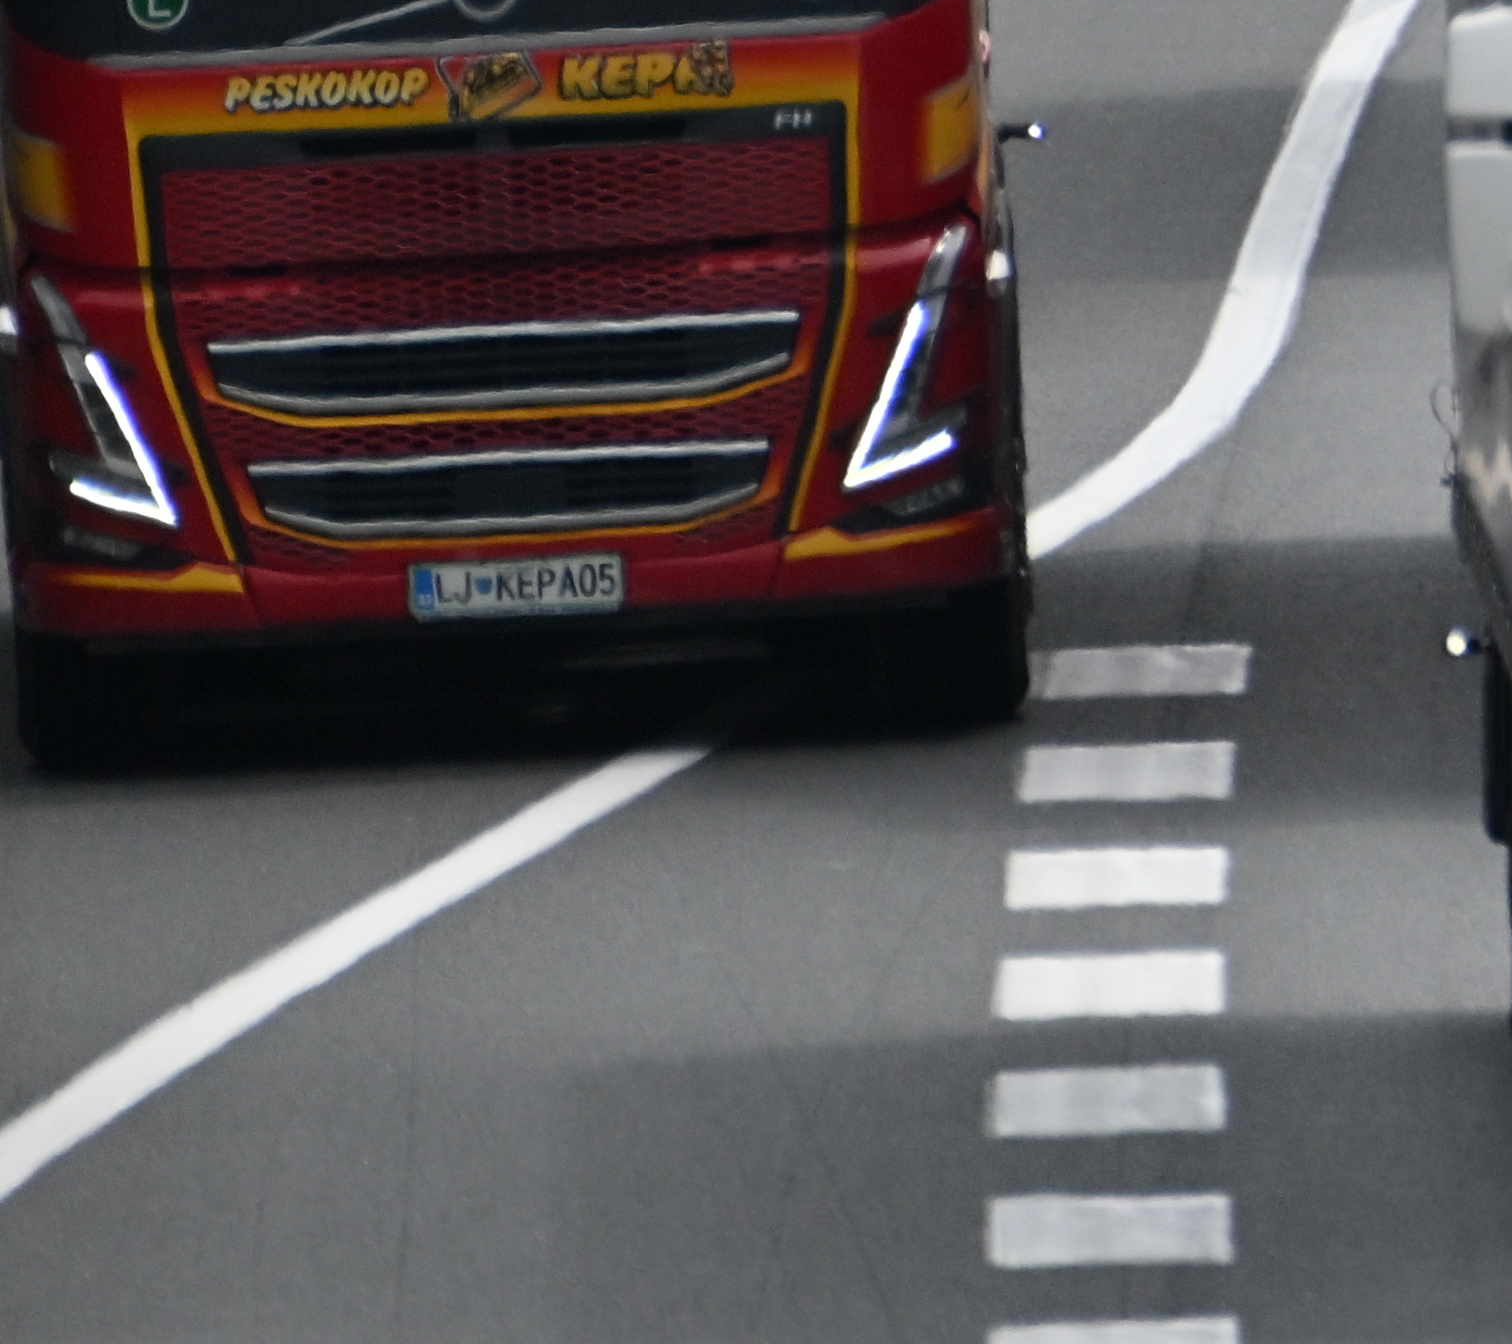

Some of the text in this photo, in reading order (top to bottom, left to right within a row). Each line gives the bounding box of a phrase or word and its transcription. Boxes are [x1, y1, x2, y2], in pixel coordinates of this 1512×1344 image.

[224, 67, 429, 112] PESKOKOP
[773, 109, 813, 130] FH
[434, 562, 616, 604] LJ KEPA05
